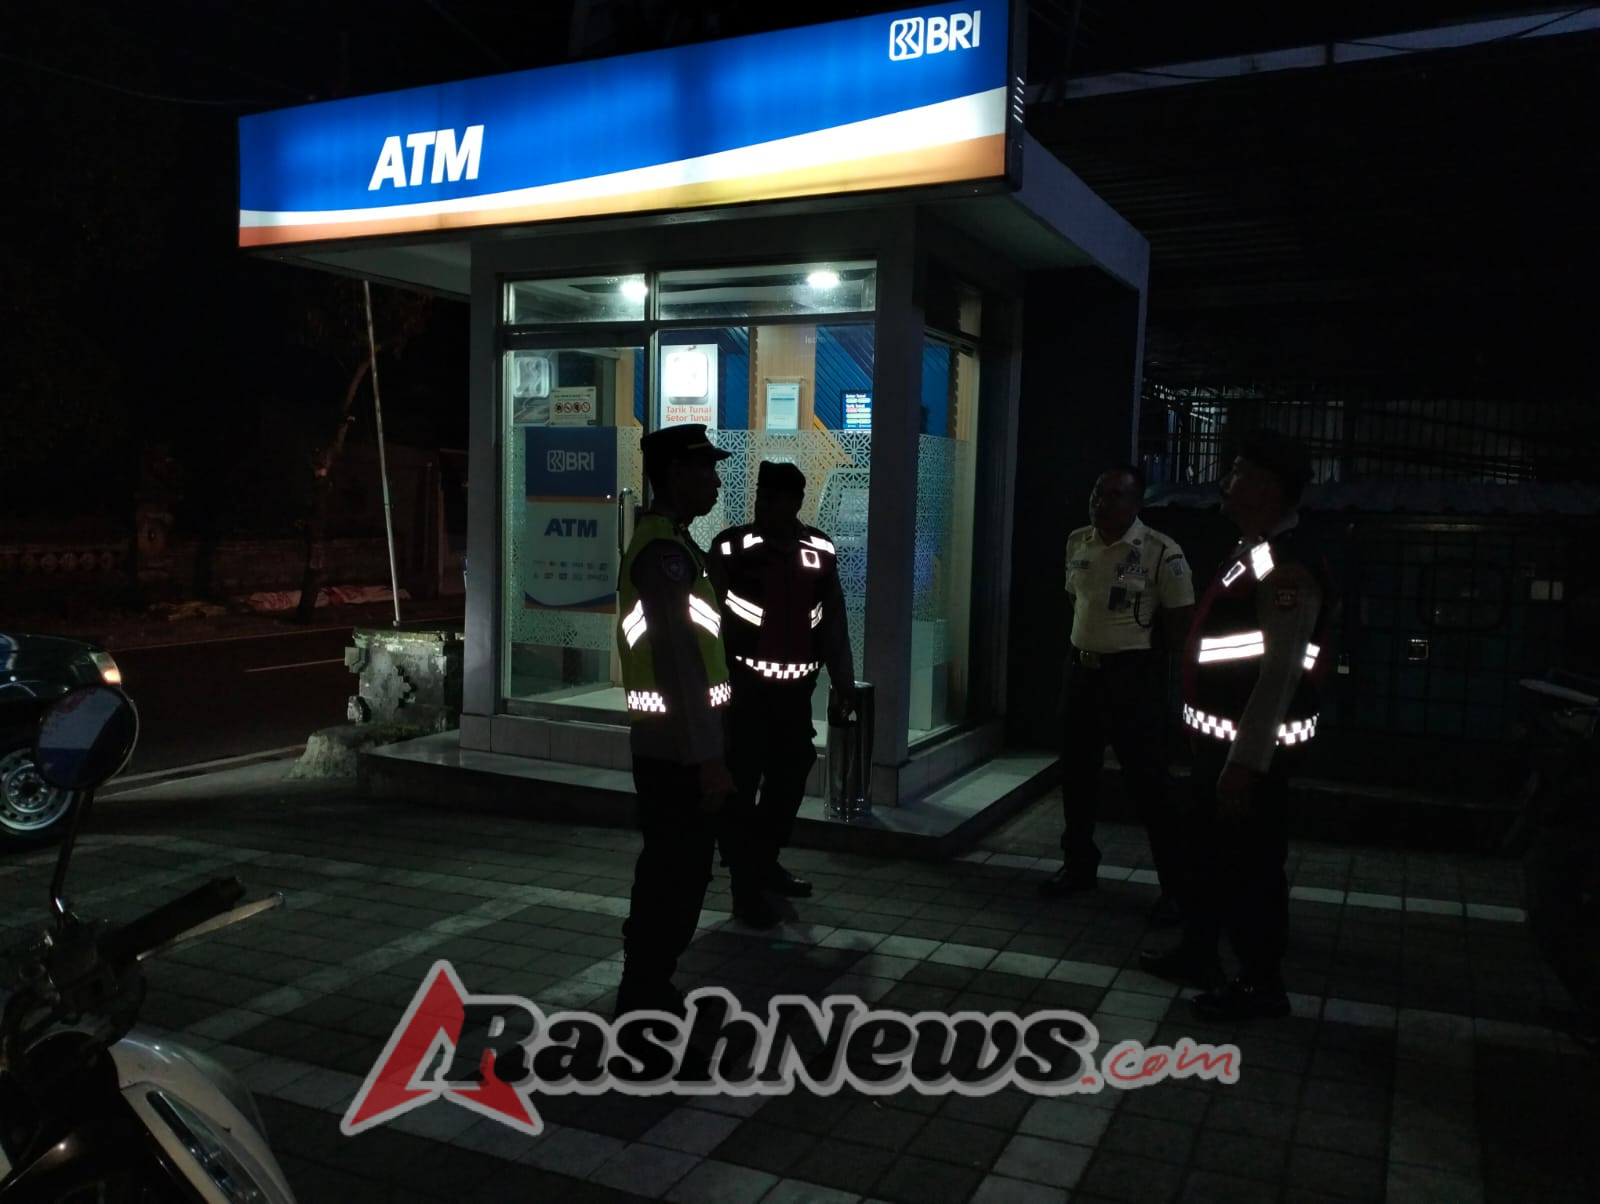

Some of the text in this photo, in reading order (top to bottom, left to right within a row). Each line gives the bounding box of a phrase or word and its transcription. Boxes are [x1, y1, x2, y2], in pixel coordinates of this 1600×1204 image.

[925, 10, 981, 54] BRI
[367, 124, 485, 191] ATM
[665, 405, 713, 414] Tarik Tunai
[665, 413, 713, 423] Setor Tunai
[566, 451, 595, 471] BRI
[544, 518, 598, 538] ATM
